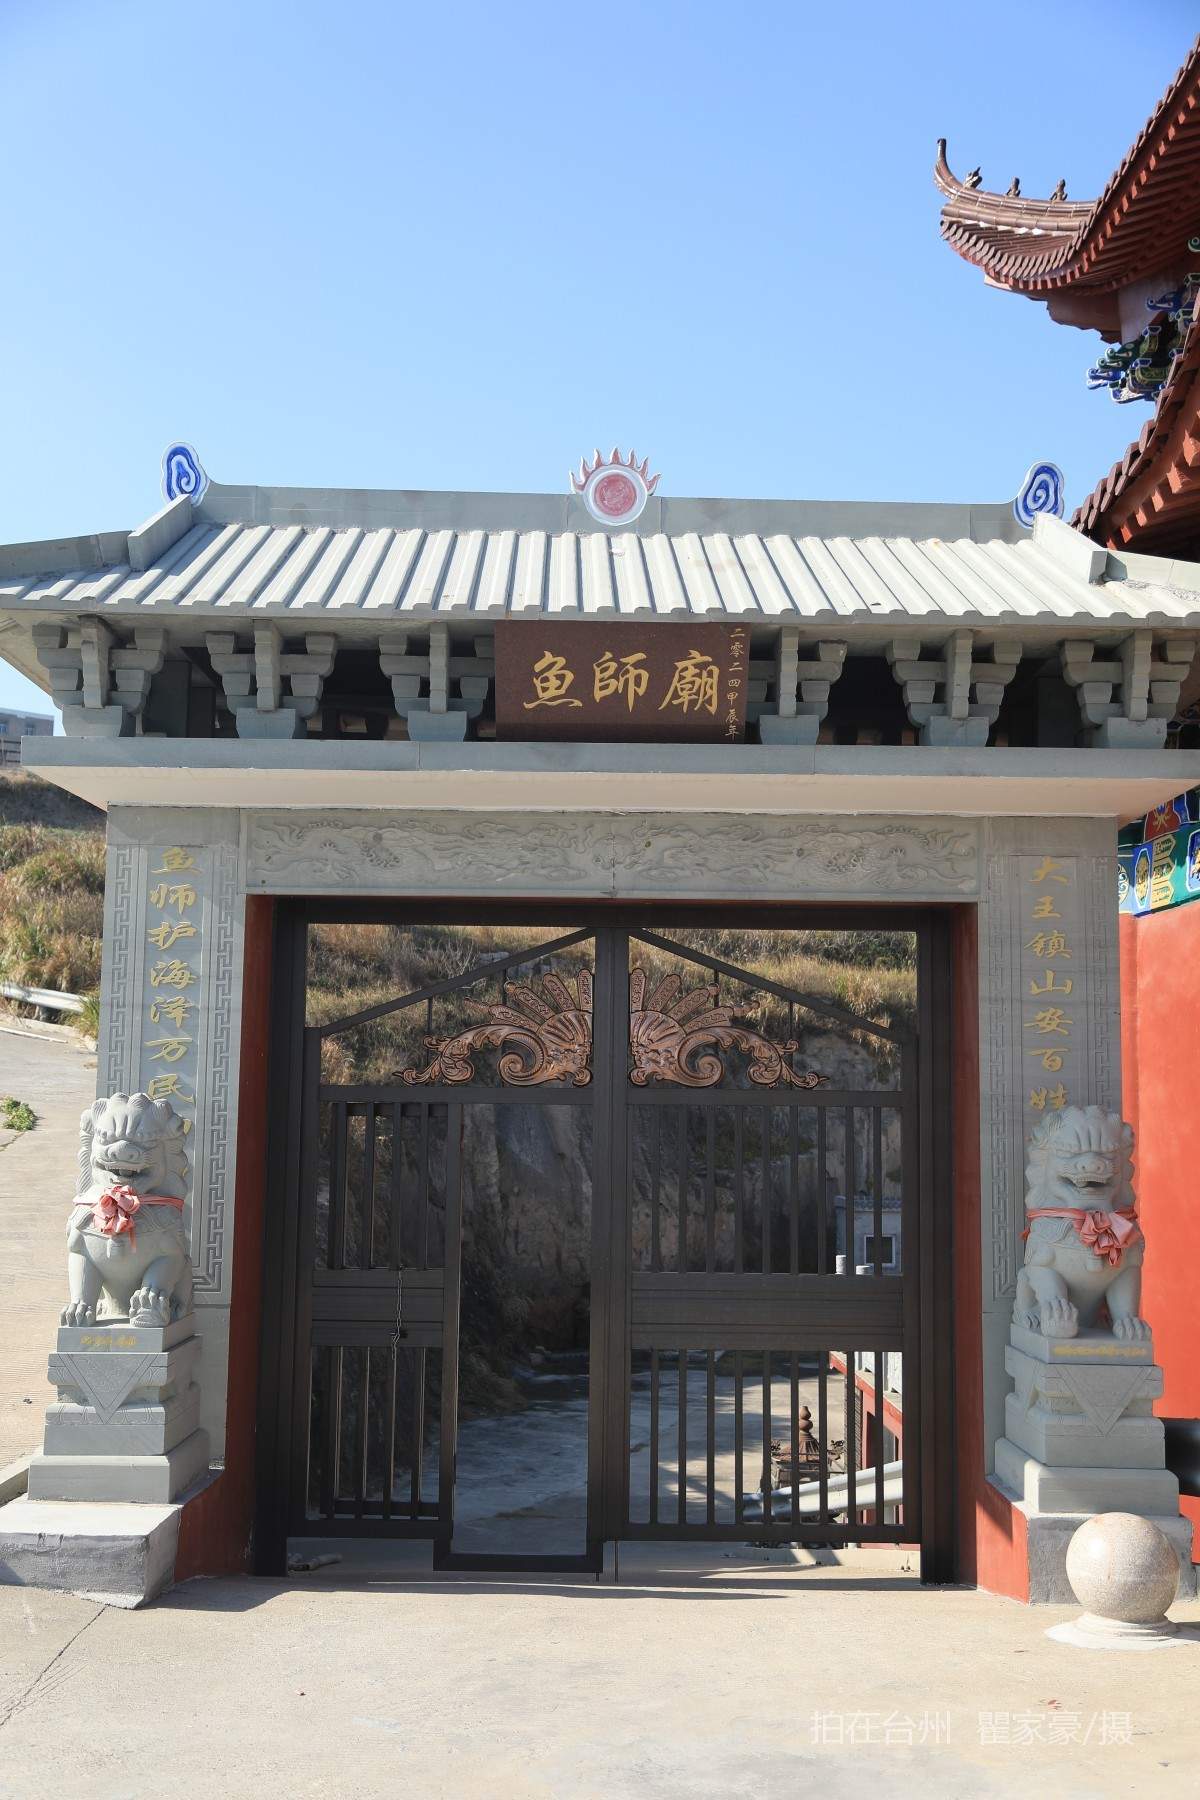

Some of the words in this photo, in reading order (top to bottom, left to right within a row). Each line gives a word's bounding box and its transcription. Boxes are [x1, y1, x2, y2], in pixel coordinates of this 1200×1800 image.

[725, 628, 745, 741] 二零二四甲辰年
